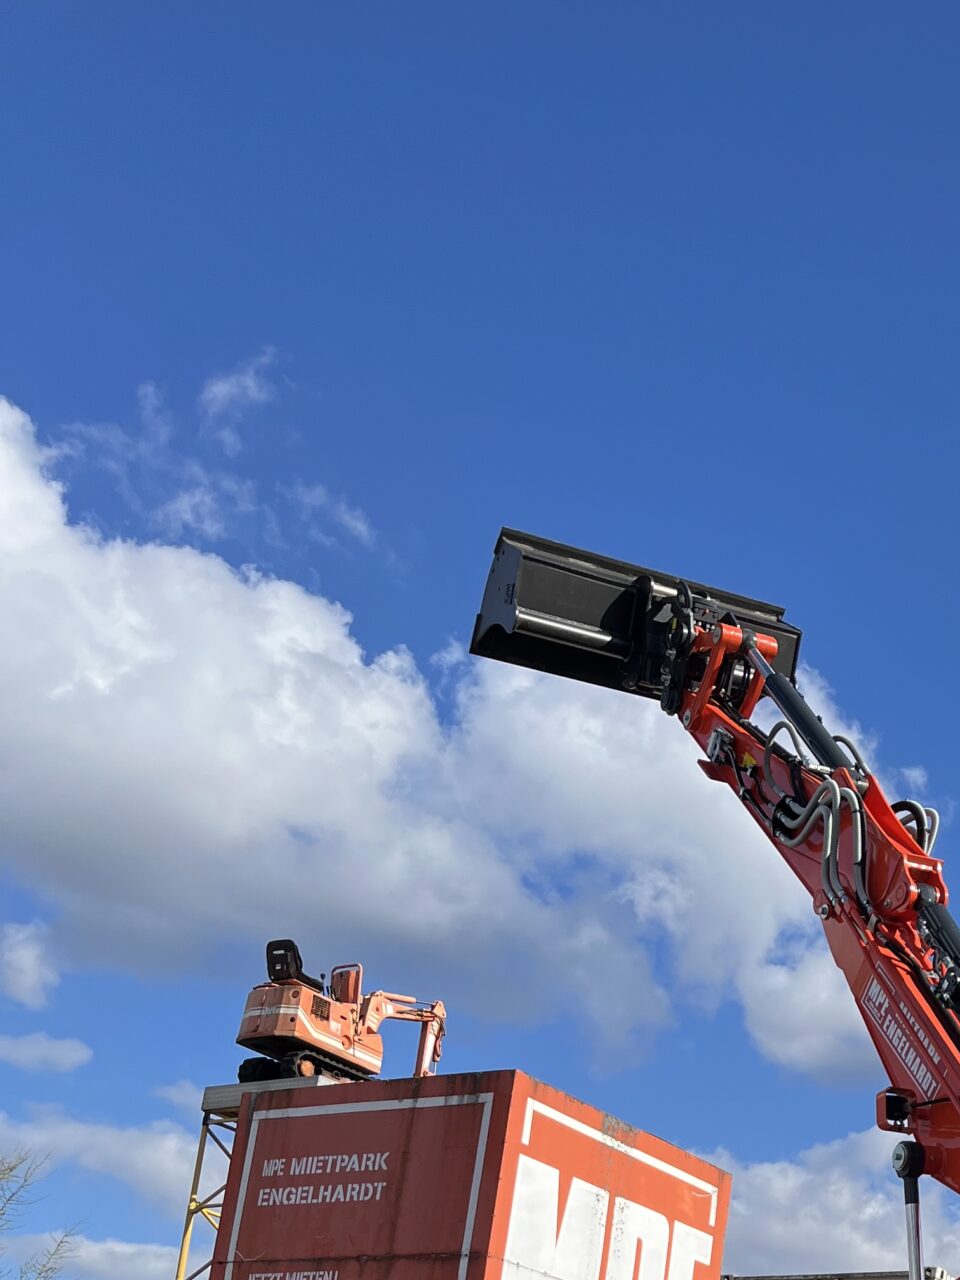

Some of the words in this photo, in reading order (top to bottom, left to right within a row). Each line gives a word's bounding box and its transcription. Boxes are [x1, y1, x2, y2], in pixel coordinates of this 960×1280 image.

[868, 979, 890, 1018] MPE
[882, 1014, 937, 1097] ENGELHARDT
[262, 1159, 285, 1177] MPE
[290, 1152, 390, 1175] MIETPARK
[257, 1182, 387, 1206] ENGELHARDT
